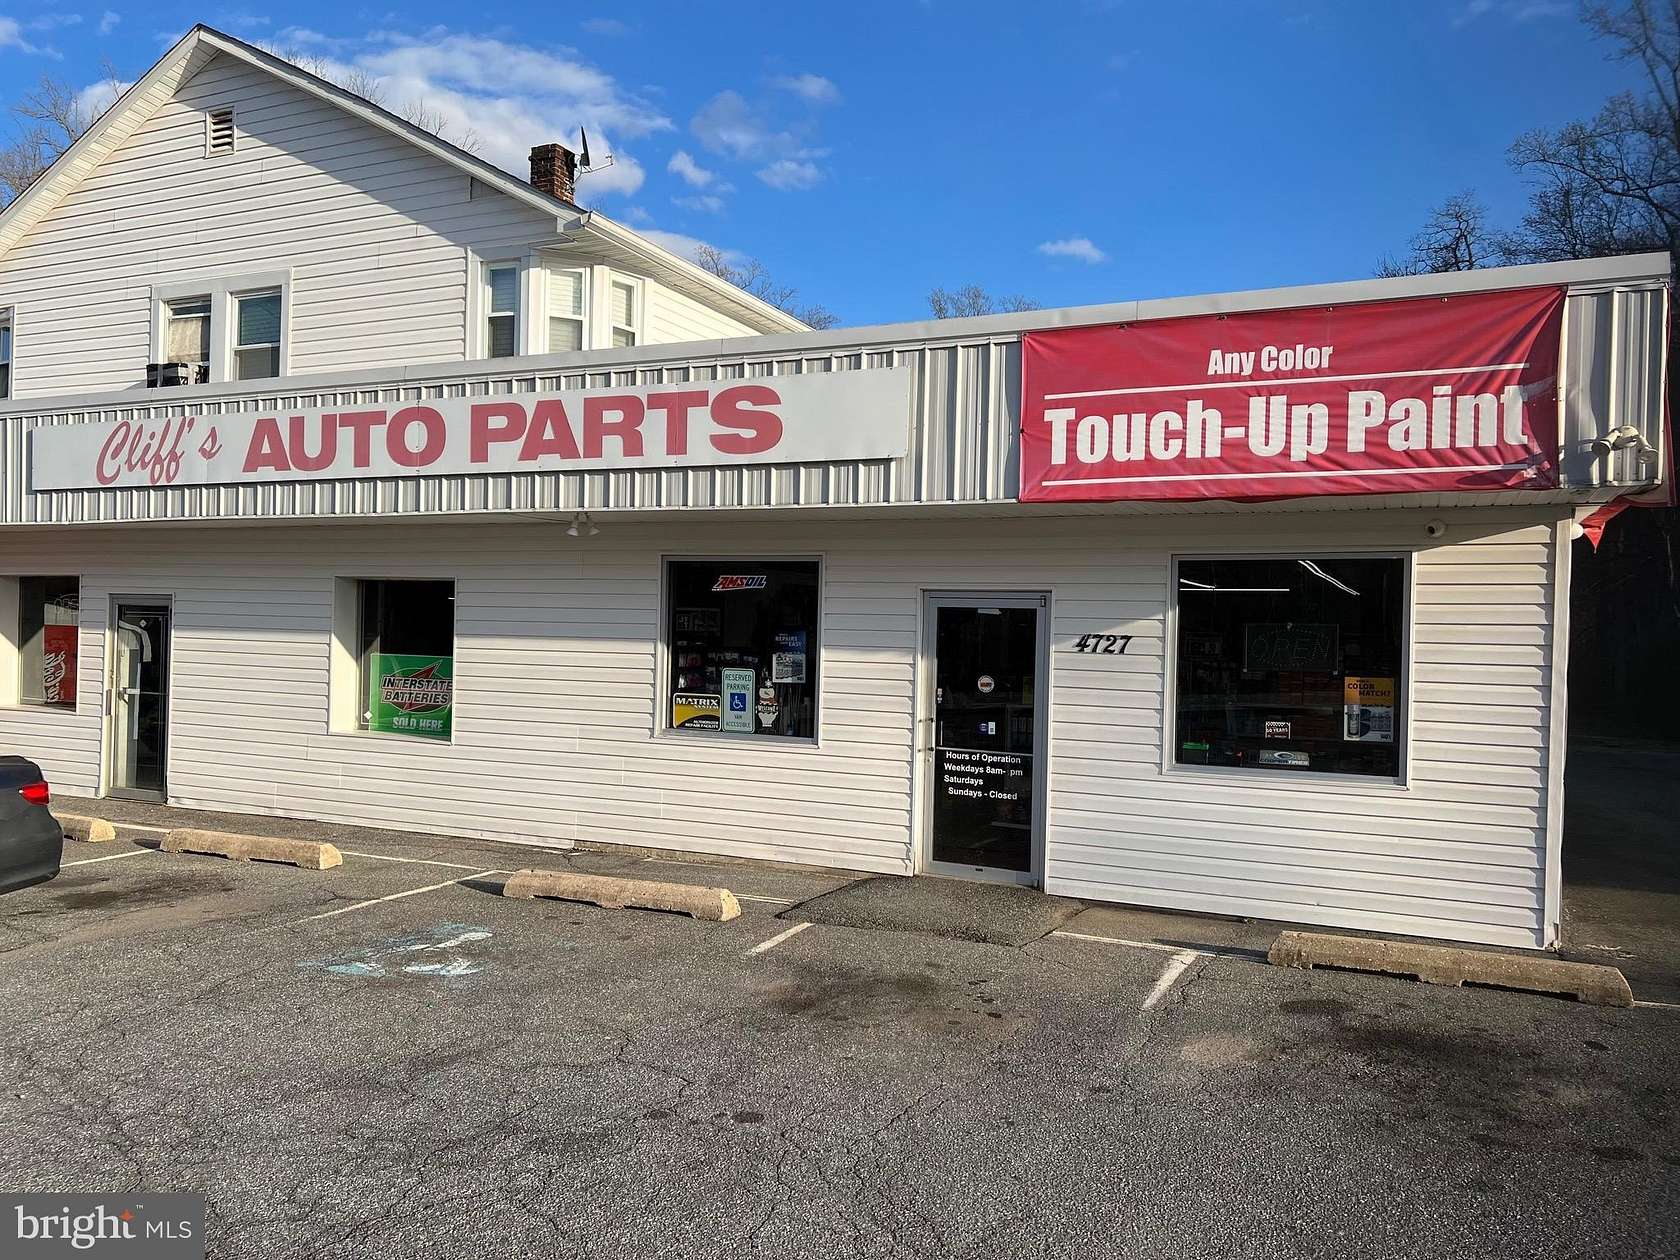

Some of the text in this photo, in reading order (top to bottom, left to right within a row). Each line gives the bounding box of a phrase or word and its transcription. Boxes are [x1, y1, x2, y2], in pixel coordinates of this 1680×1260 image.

[1207, 344, 1334, 376] Any Color
[1044, 385, 1529, 465] Touch-Up Paint
[96, 385, 783, 486] Cliff's AUTO PARTS
[713, 575, 767, 590] AMSOIL
[1075, 634, 1133, 655] 4727
[381, 676, 453, 692] INTERSTATE
[725, 673, 752, 682] RESERVED
[727, 683, 750, 691] PARKING
[383, 690, 449, 704] BATTERIES
[675, 697, 719, 706] MATRIX
[393, 716, 443, 732] SOLD HERE
[946, 751, 1021, 764] Hours of Operation
[944, 762, 1023, 777] Weekdays 8am- pm
[944, 774, 984, 787] Saturdays
[948, 786, 982, 798] Sundays
[989, 790, 1018, 800] Closed
